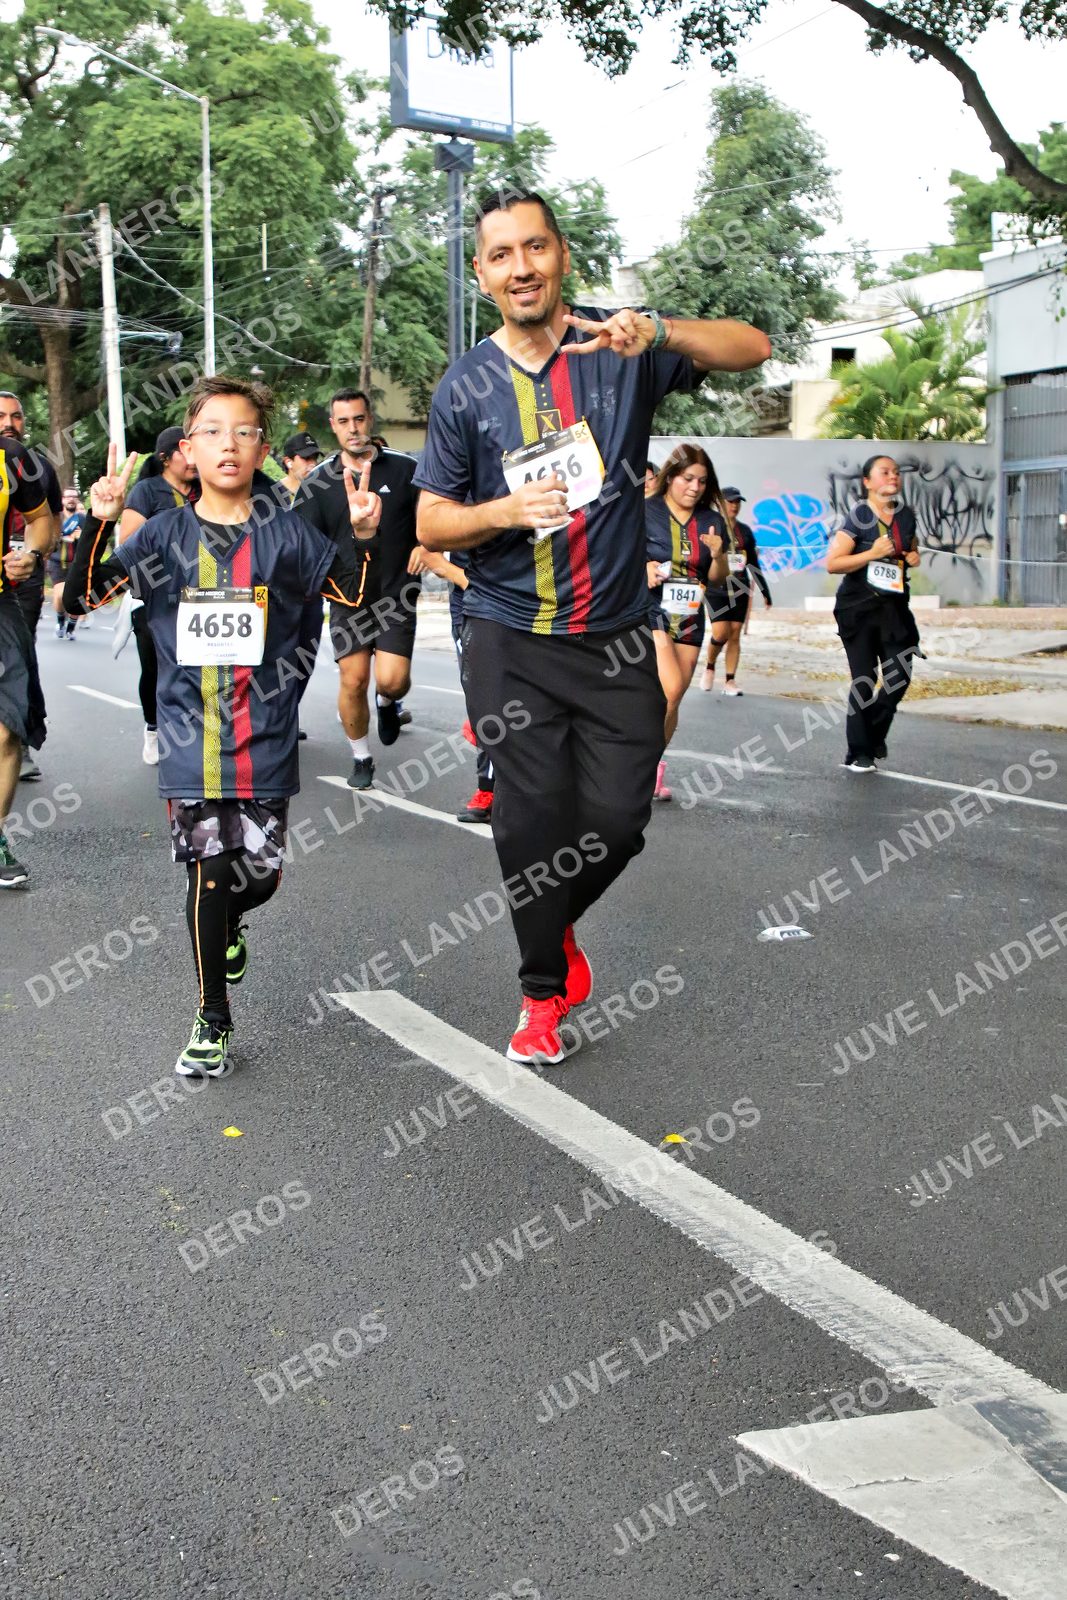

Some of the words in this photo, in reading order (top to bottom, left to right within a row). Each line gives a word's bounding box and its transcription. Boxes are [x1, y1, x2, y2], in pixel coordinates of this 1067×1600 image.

[873, 565, 897, 580] 6788
[670, 588, 696, 602] 1841
[187, 613, 253, 638] 4658
